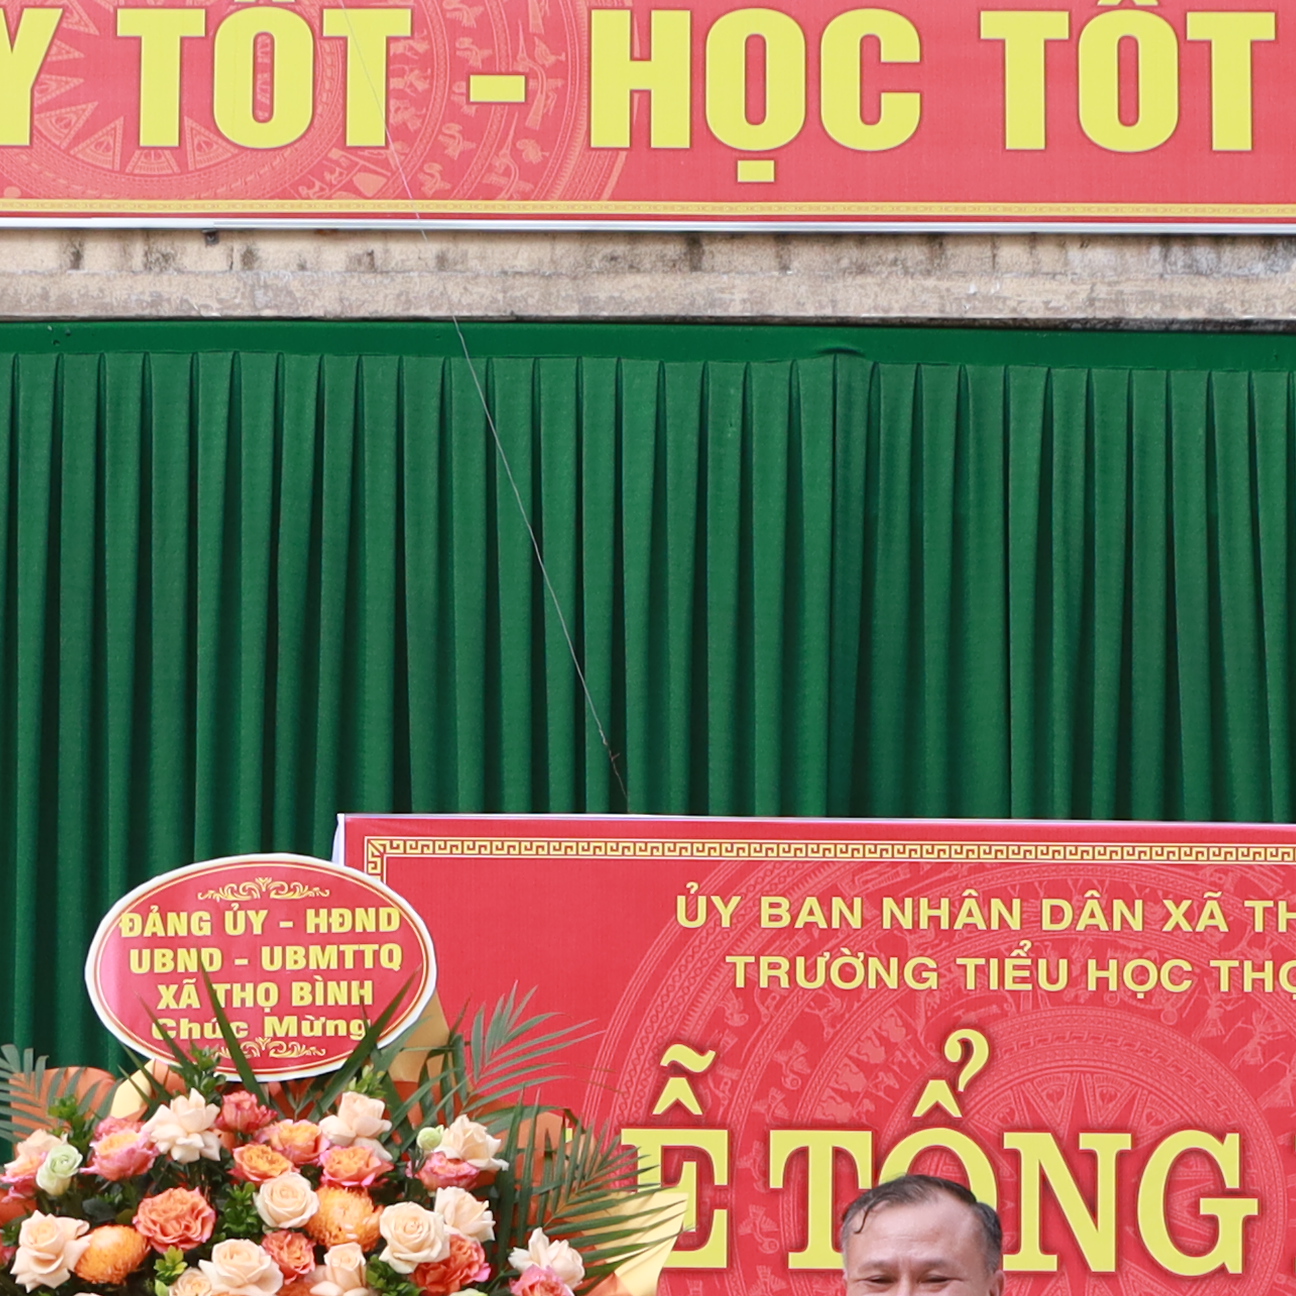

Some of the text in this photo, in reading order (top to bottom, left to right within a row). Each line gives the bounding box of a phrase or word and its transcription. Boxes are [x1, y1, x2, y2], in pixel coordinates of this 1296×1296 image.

[470, 74, 526, 103] -
[591, 8, 921, 183] HỌC
[118, 905, 212, 938] ĐẢNG
[224, 903, 268, 935] ỦY
[306, 906, 401, 933] HĐND
[676, 882, 741, 928] ỦY
[760, 896, 862, 929] BAN
[882, 889, 1021, 930] NHÂN
[1041, 890, 1143, 931] DÂN
[1163, 891, 1229, 932] XÃ
[129, 947, 222, 974] UBND
[261, 943, 402, 971] UBMTTQ
[726, 948, 938, 990] TRƯỜNG
[956, 940, 1068, 990] TIỂU
[1087, 959, 1193, 998] HỌC
[157, 975, 373, 1013] XÃ THỌ BÌNH
[152, 1014, 371, 1041] Chúc Mừng
